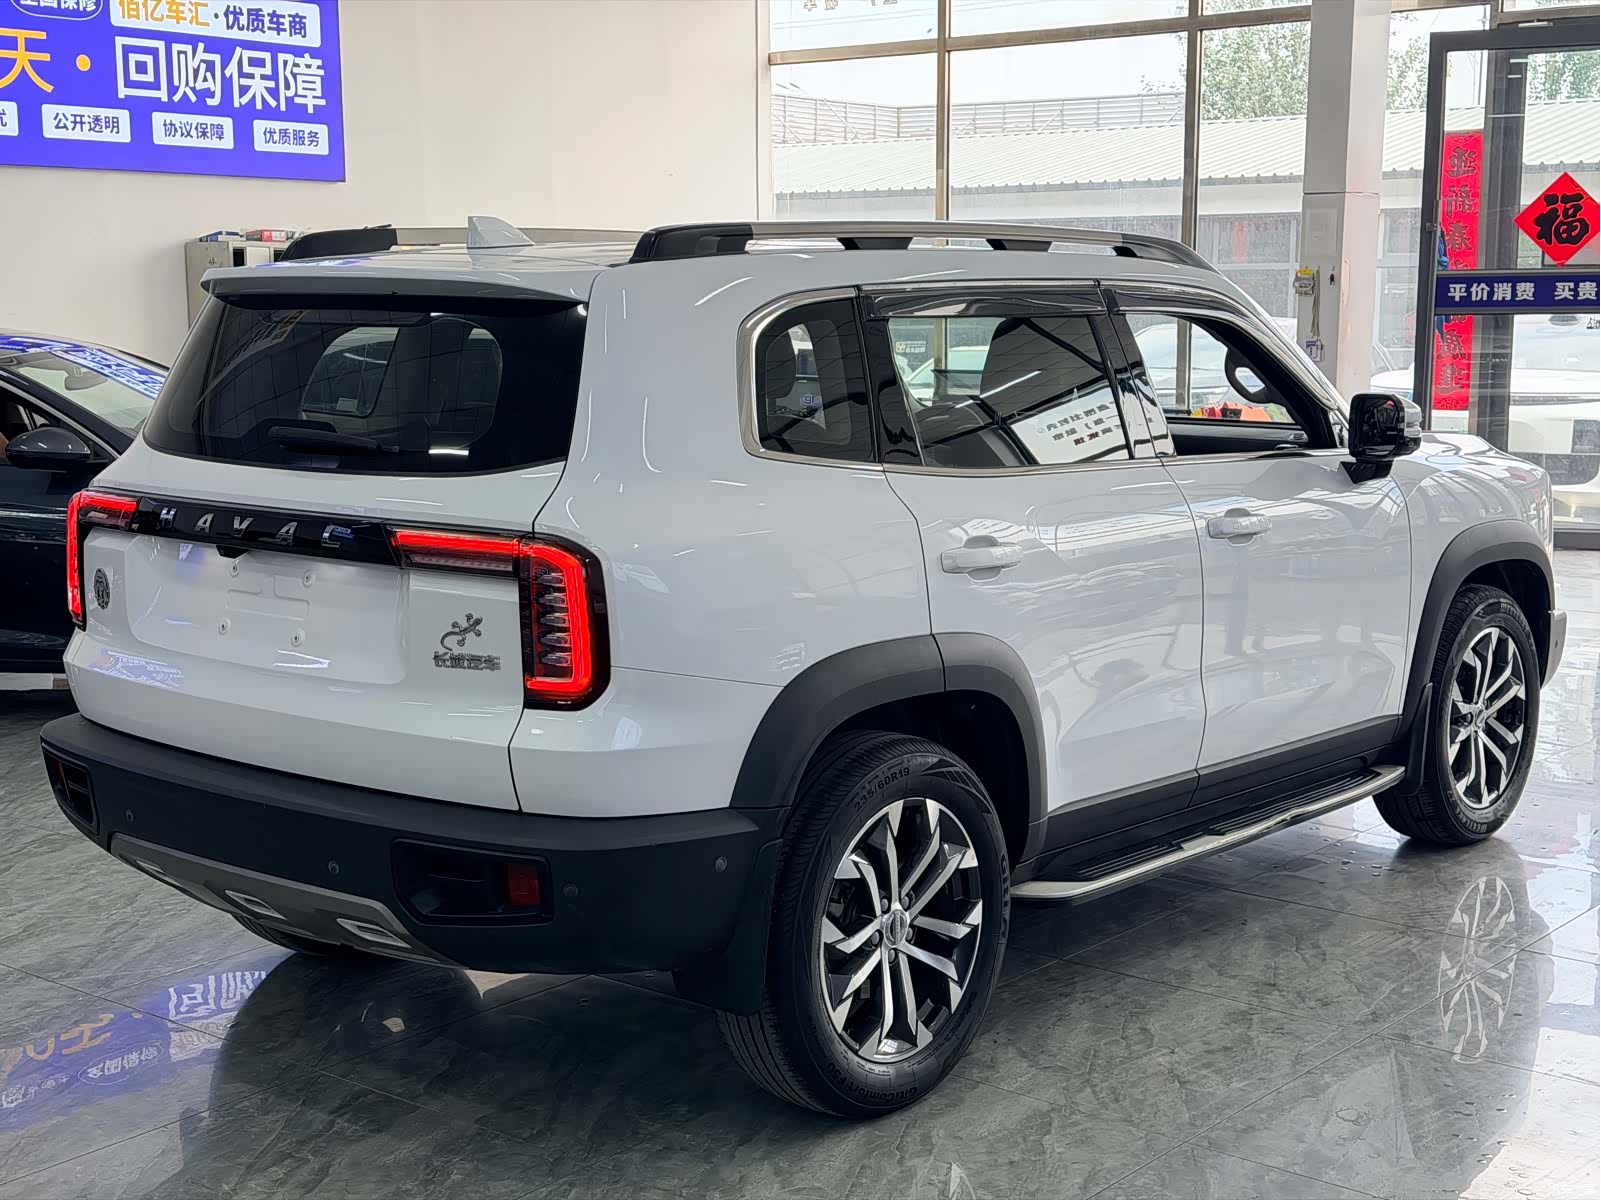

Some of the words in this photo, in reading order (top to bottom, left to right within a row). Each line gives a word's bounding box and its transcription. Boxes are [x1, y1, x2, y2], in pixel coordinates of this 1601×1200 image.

[53, 112, 121, 135] 公开透明
[163, 120, 225, 142] 协议保障
[263, 127, 321, 148] 优质服务
[1535, 193, 1590, 246] 福
[1447, 282, 1535, 302] 平价消费
[1554, 281, 1598, 301] 买贵
[158, 507, 342, 549] HAVAL
[853, 767, 910, 813] 235/60R19
